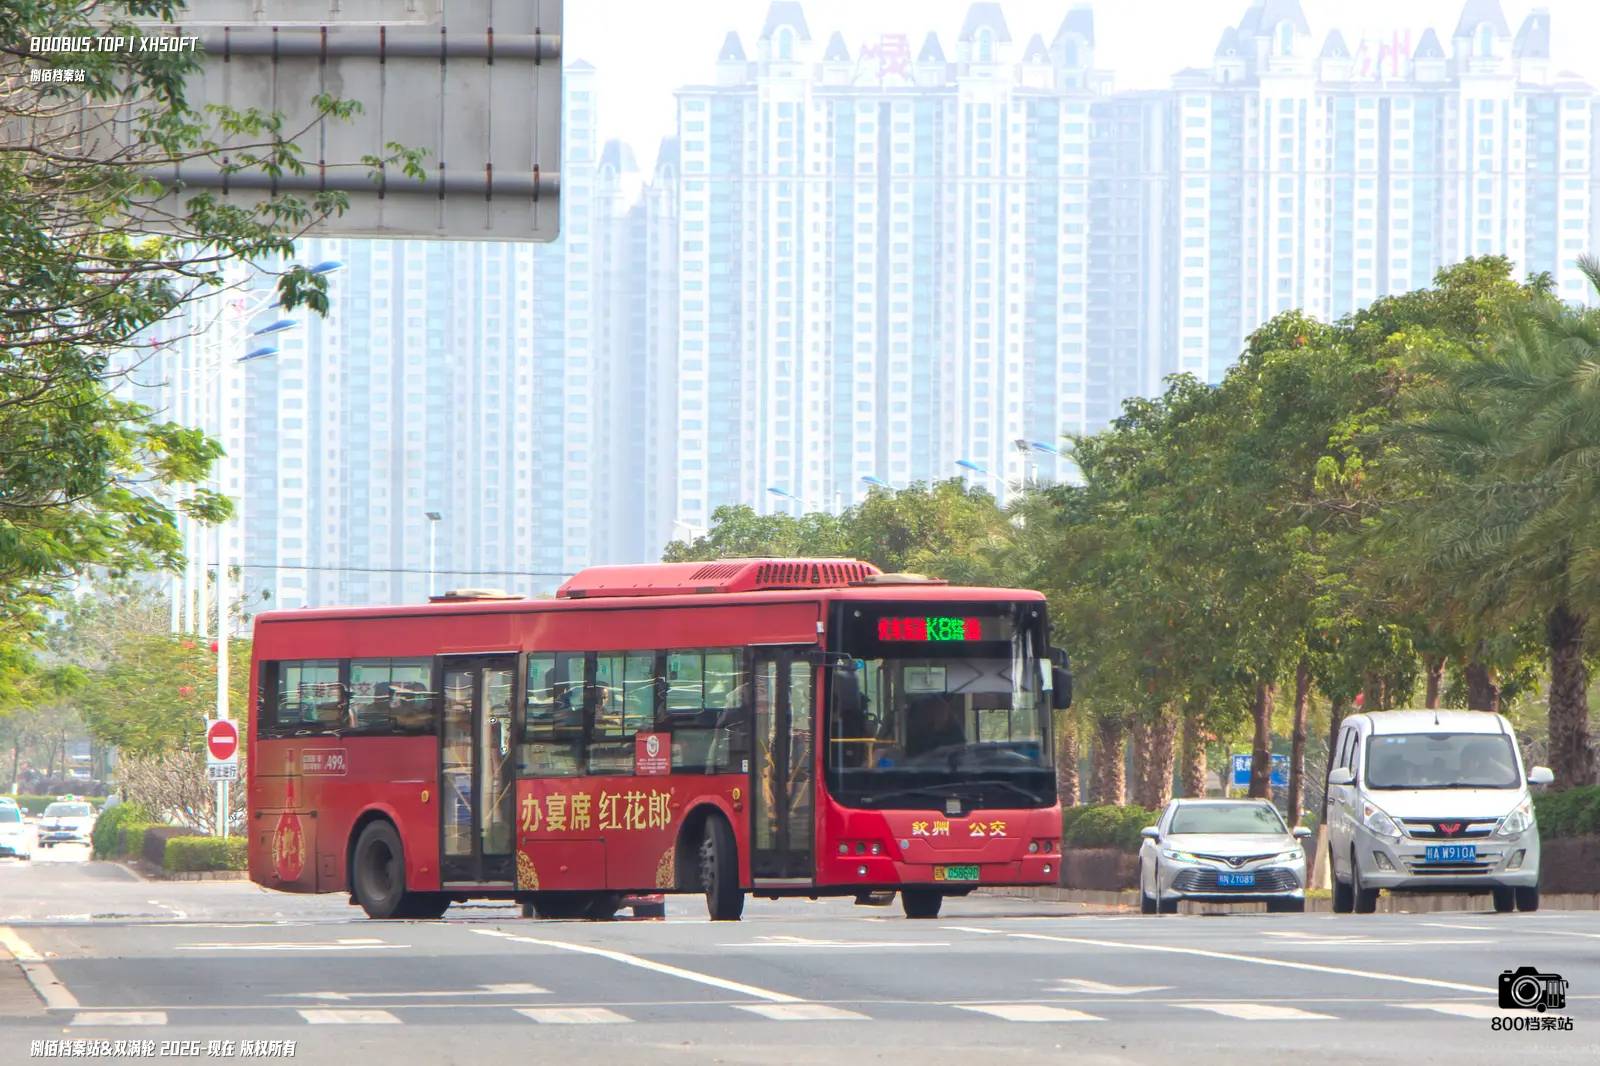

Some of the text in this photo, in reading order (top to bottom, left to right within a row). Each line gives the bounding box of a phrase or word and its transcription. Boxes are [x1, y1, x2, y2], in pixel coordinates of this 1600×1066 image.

[521, 788, 672, 832] 办宴席 红花郎
[969, 820, 1007, 837] 公交
